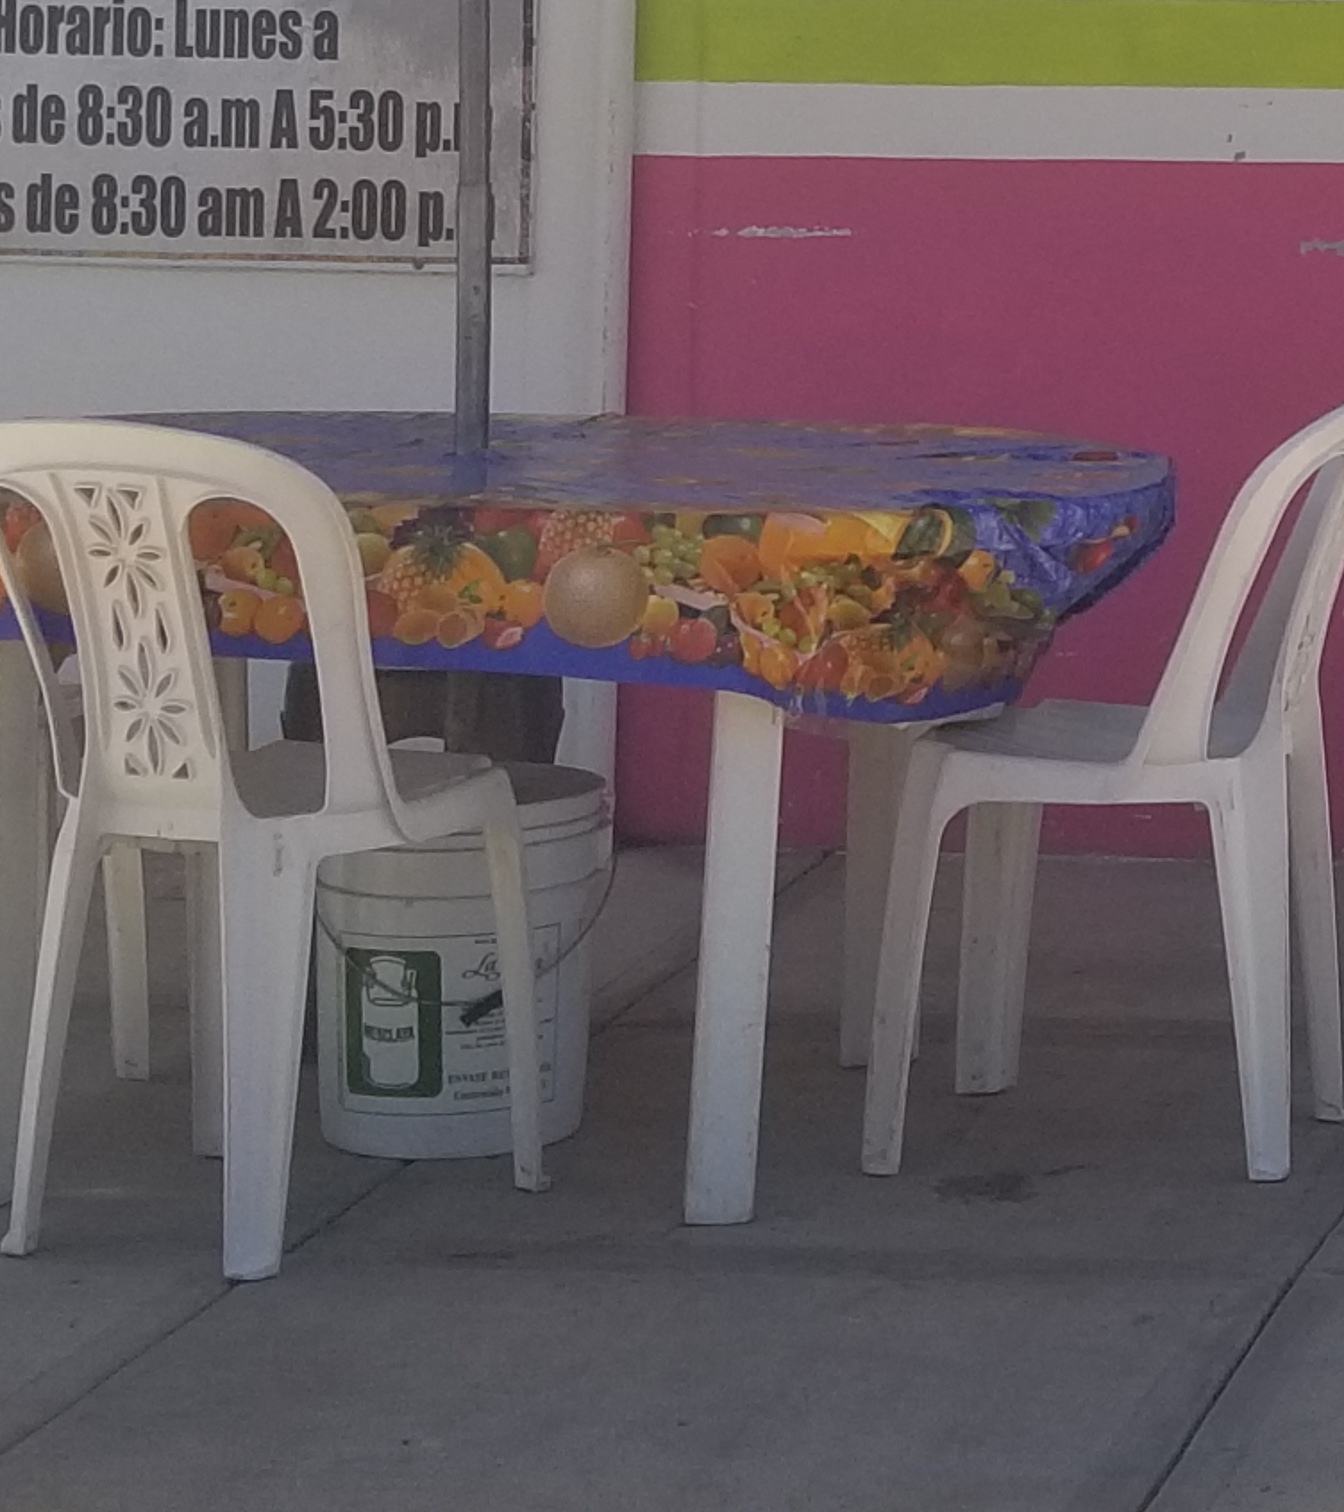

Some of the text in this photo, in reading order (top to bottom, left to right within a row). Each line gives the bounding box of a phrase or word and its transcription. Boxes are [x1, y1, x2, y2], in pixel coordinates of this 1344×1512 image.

[312, 7, 339, 61] a
[12, 83, 66, 146] de
[76, 83, 172, 148] 8:30
[270, 88, 298, 150] A
[308, 88, 405, 153] 5:30
[26, 173, 80, 234] de
[91, 172, 187, 239] 8:30
[198, 184, 265, 239] am
[273, 178, 302, 239] A
[312, 178, 407, 240] 2:00
